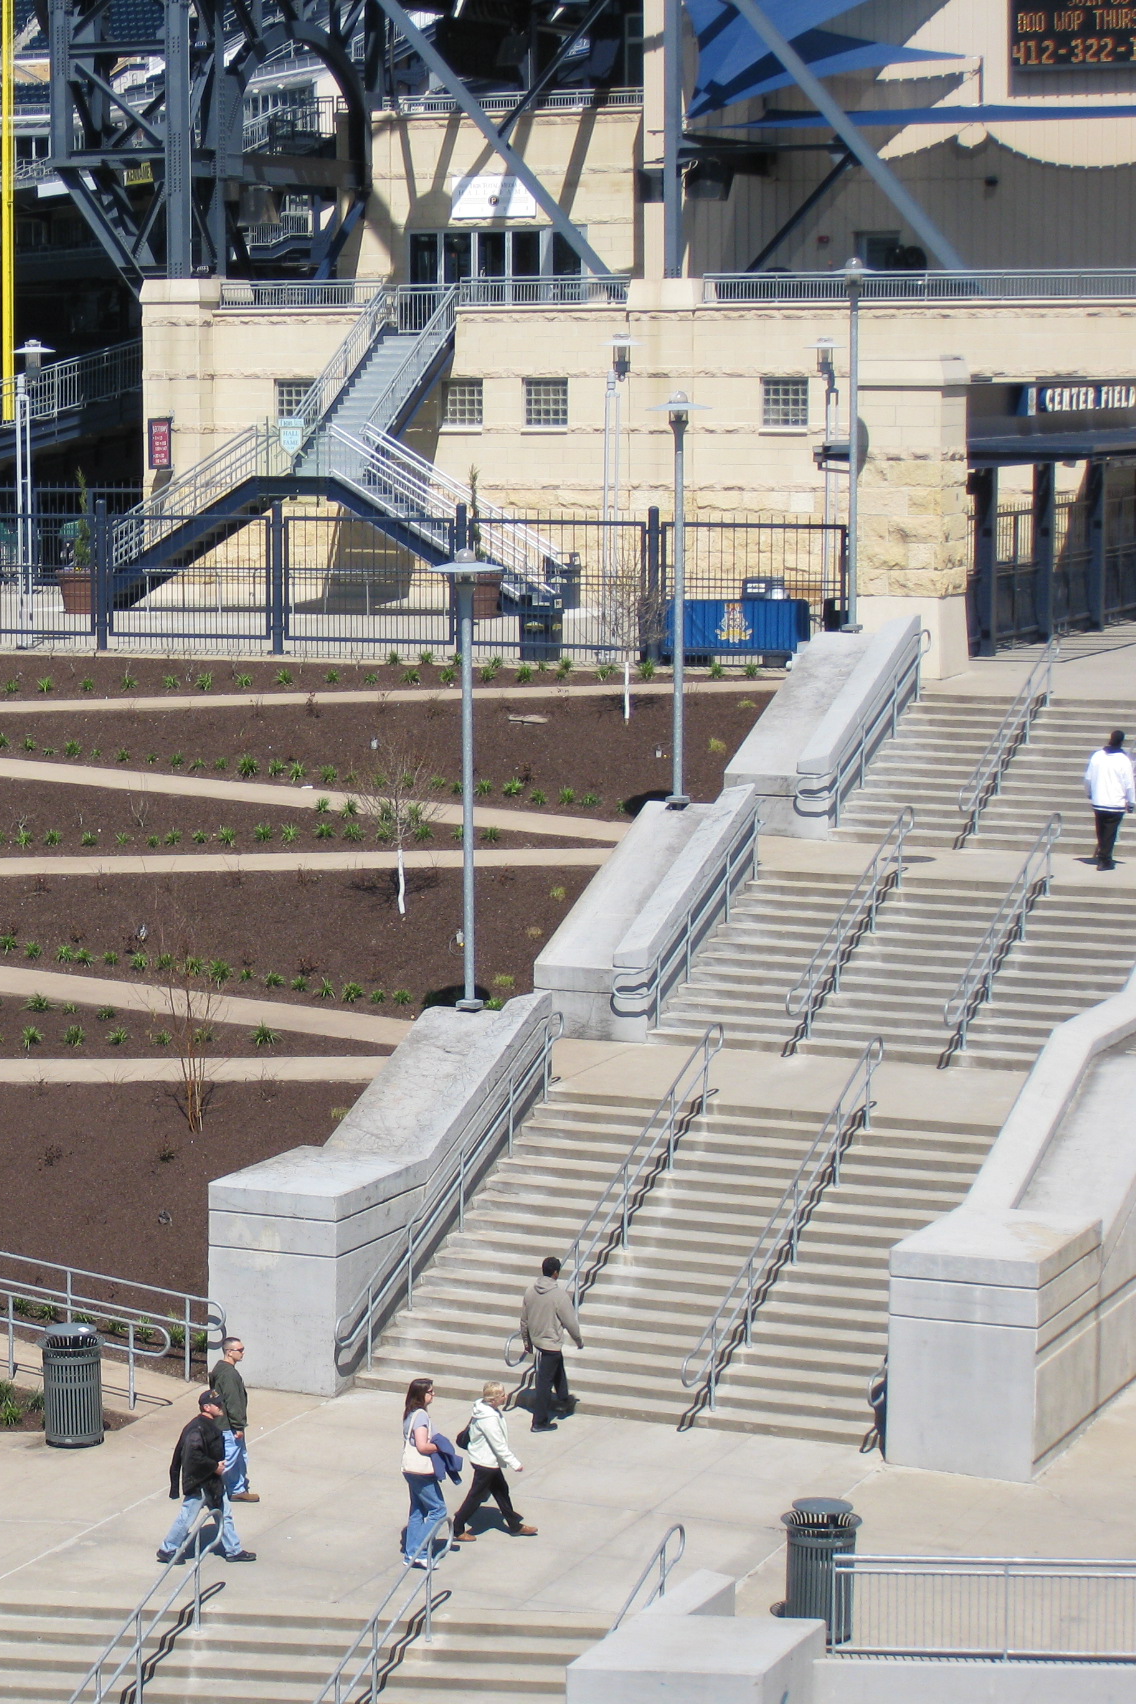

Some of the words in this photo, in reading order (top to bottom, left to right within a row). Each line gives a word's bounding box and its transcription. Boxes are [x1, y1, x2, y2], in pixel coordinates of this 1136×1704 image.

[1054, 9, 1084, 31] WOP
[1045, 387, 1095, 412] CENTER
[1100, 385, 1136, 409] FIELD
